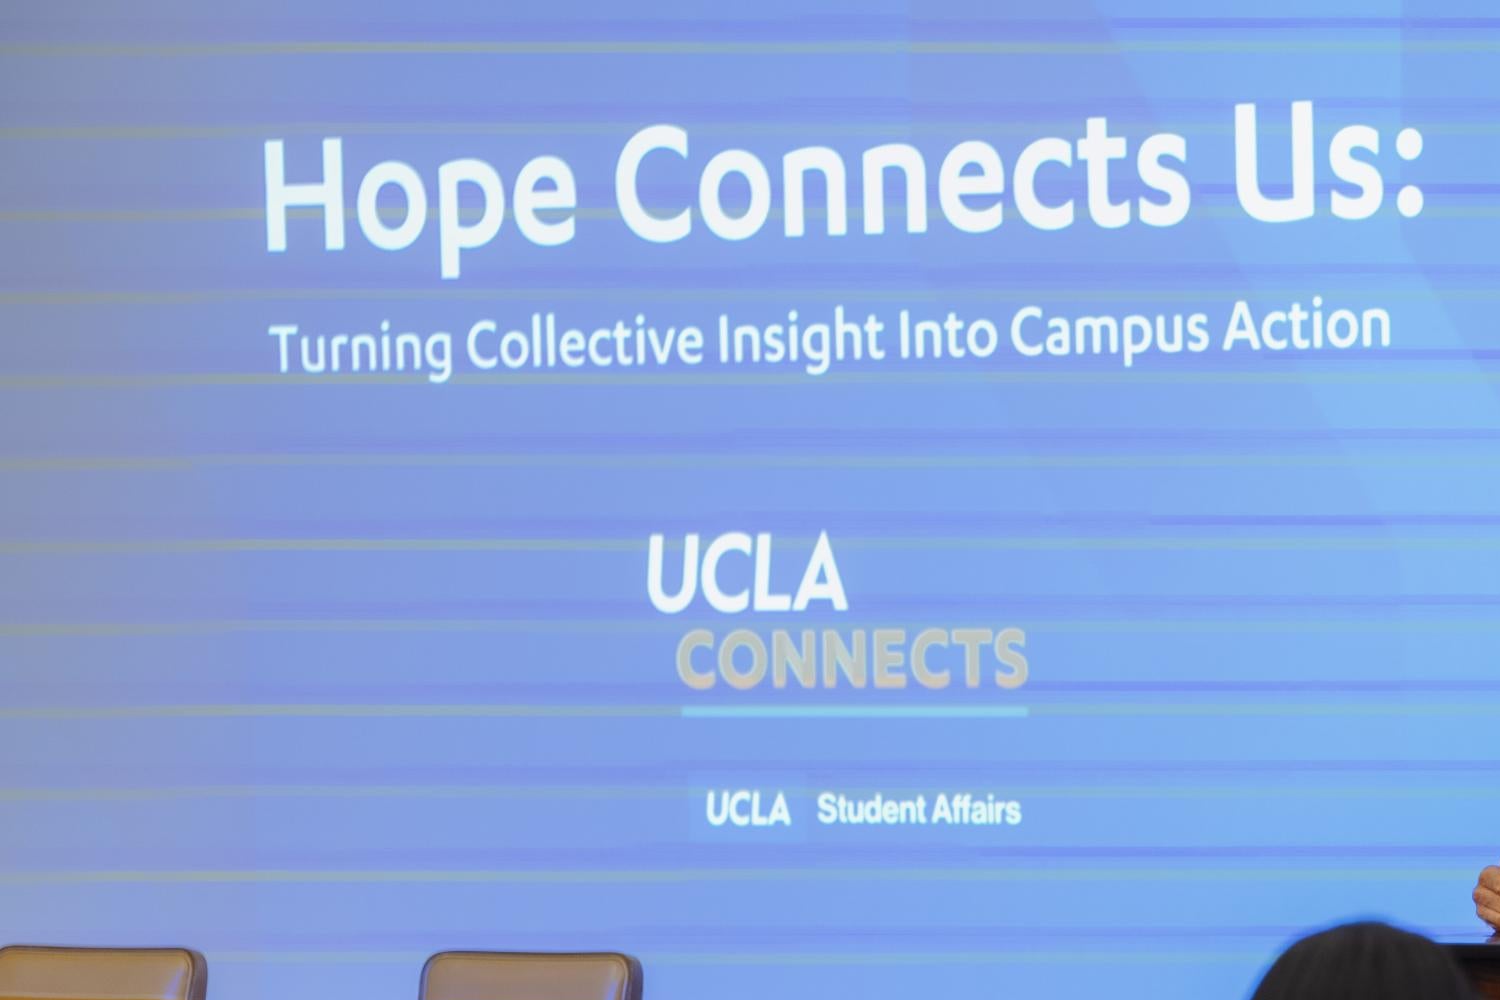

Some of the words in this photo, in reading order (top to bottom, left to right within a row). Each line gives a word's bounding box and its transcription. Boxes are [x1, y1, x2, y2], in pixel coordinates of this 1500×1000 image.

[265, 138, 577, 278] Hope
[616, 117, 1190, 242] Connects
[1235, 100, 1424, 222] Us:
[269, 321, 452, 383] Turning
[467, 313, 703, 368] Collective
[719, 306, 885, 375] Insight
[900, 310, 998, 358] Into
[1011, 306, 1209, 366] Campus
[1223, 296, 1390, 350] Action
[648, 530, 848, 613] UCLA
[676, 627, 1028, 689] CONNECTS
[706, 790, 791, 826] UCLA
[817, 792, 926, 823] Student
[932, 793, 1022, 824] Affairs
